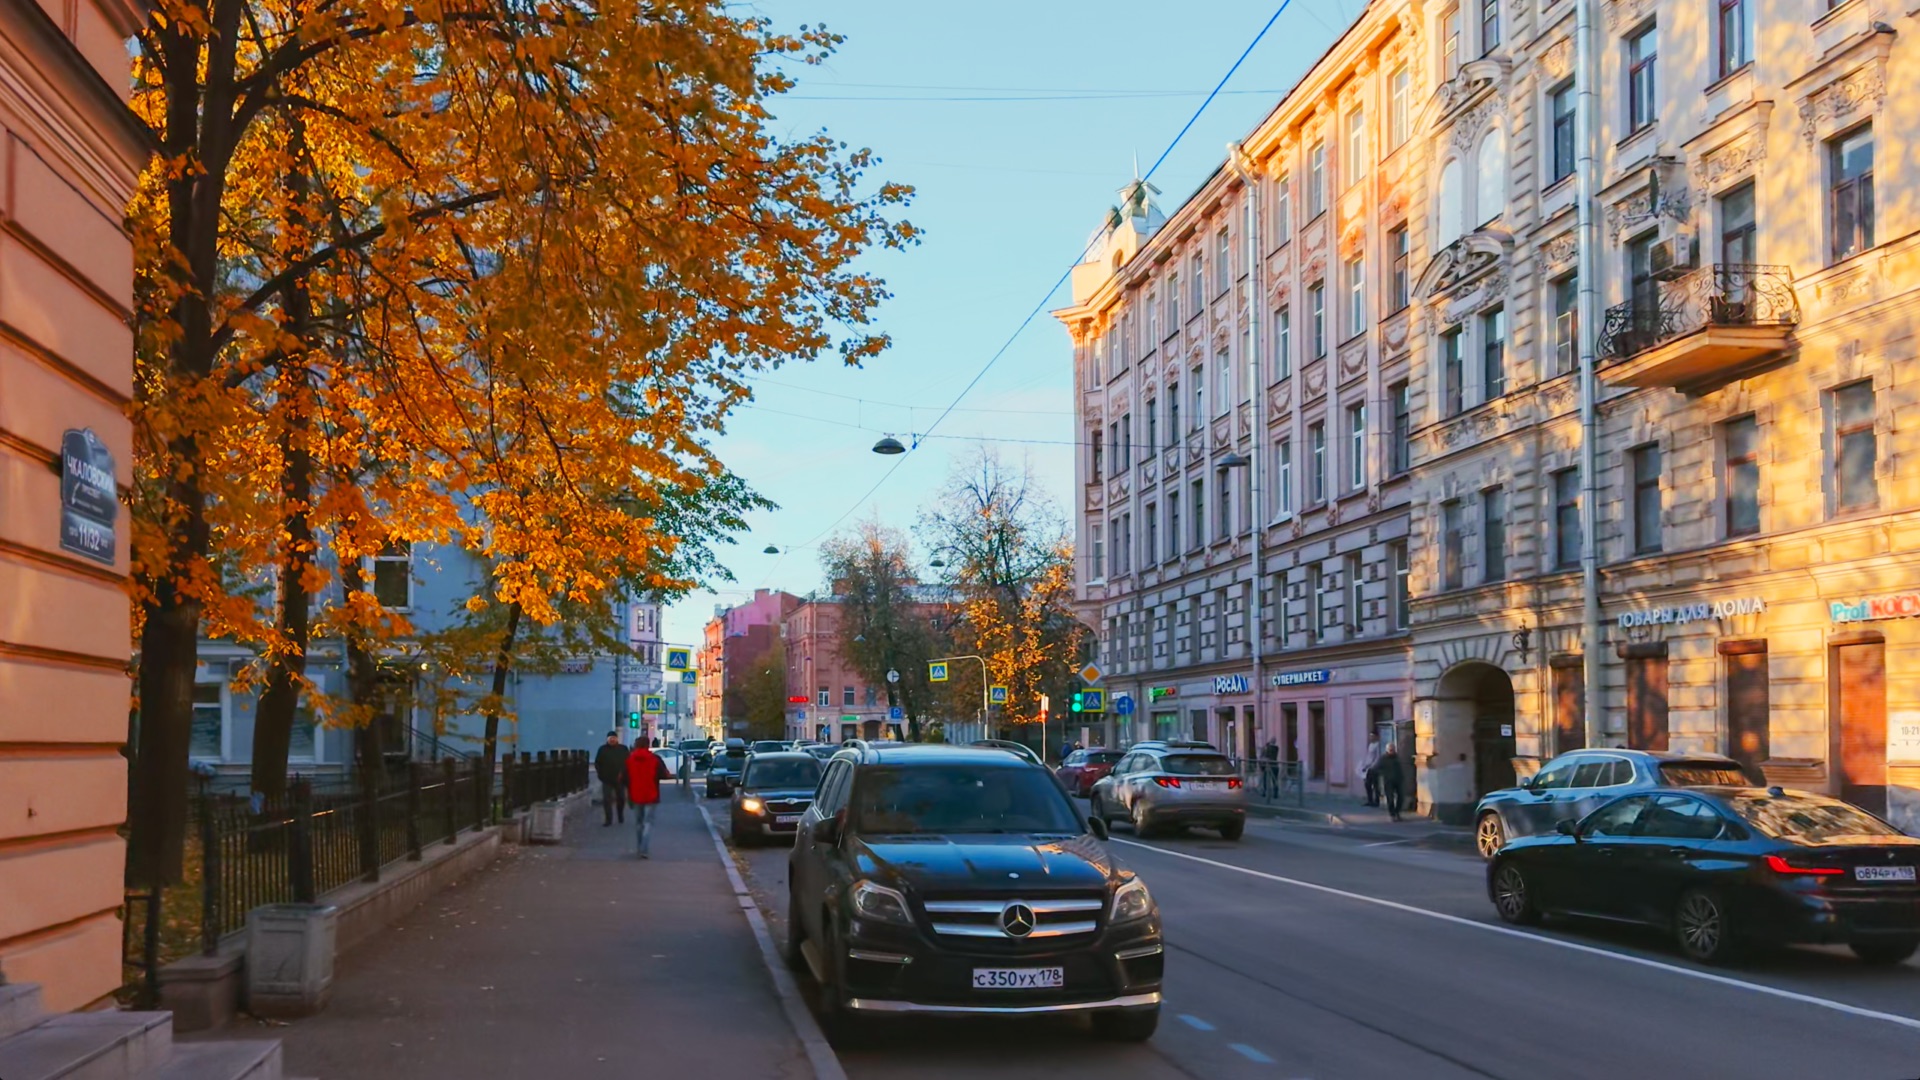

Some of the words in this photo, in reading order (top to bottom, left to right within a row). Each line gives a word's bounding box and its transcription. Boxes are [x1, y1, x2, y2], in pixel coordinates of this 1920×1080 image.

[67, 455, 114, 496] ЧКАЛОВСКИЙ
[79, 522, 100, 551] 11/32
[1617, 608, 1673, 628] ТОВАРЫ
[1676, 603, 1710, 624] ДЛЯ
[1712, 597, 1766, 619] ДОМА
[1272, 670, 1322, 686] СУПЕРМАРКЕТ
[1039, 969, 1060, 981] 178
